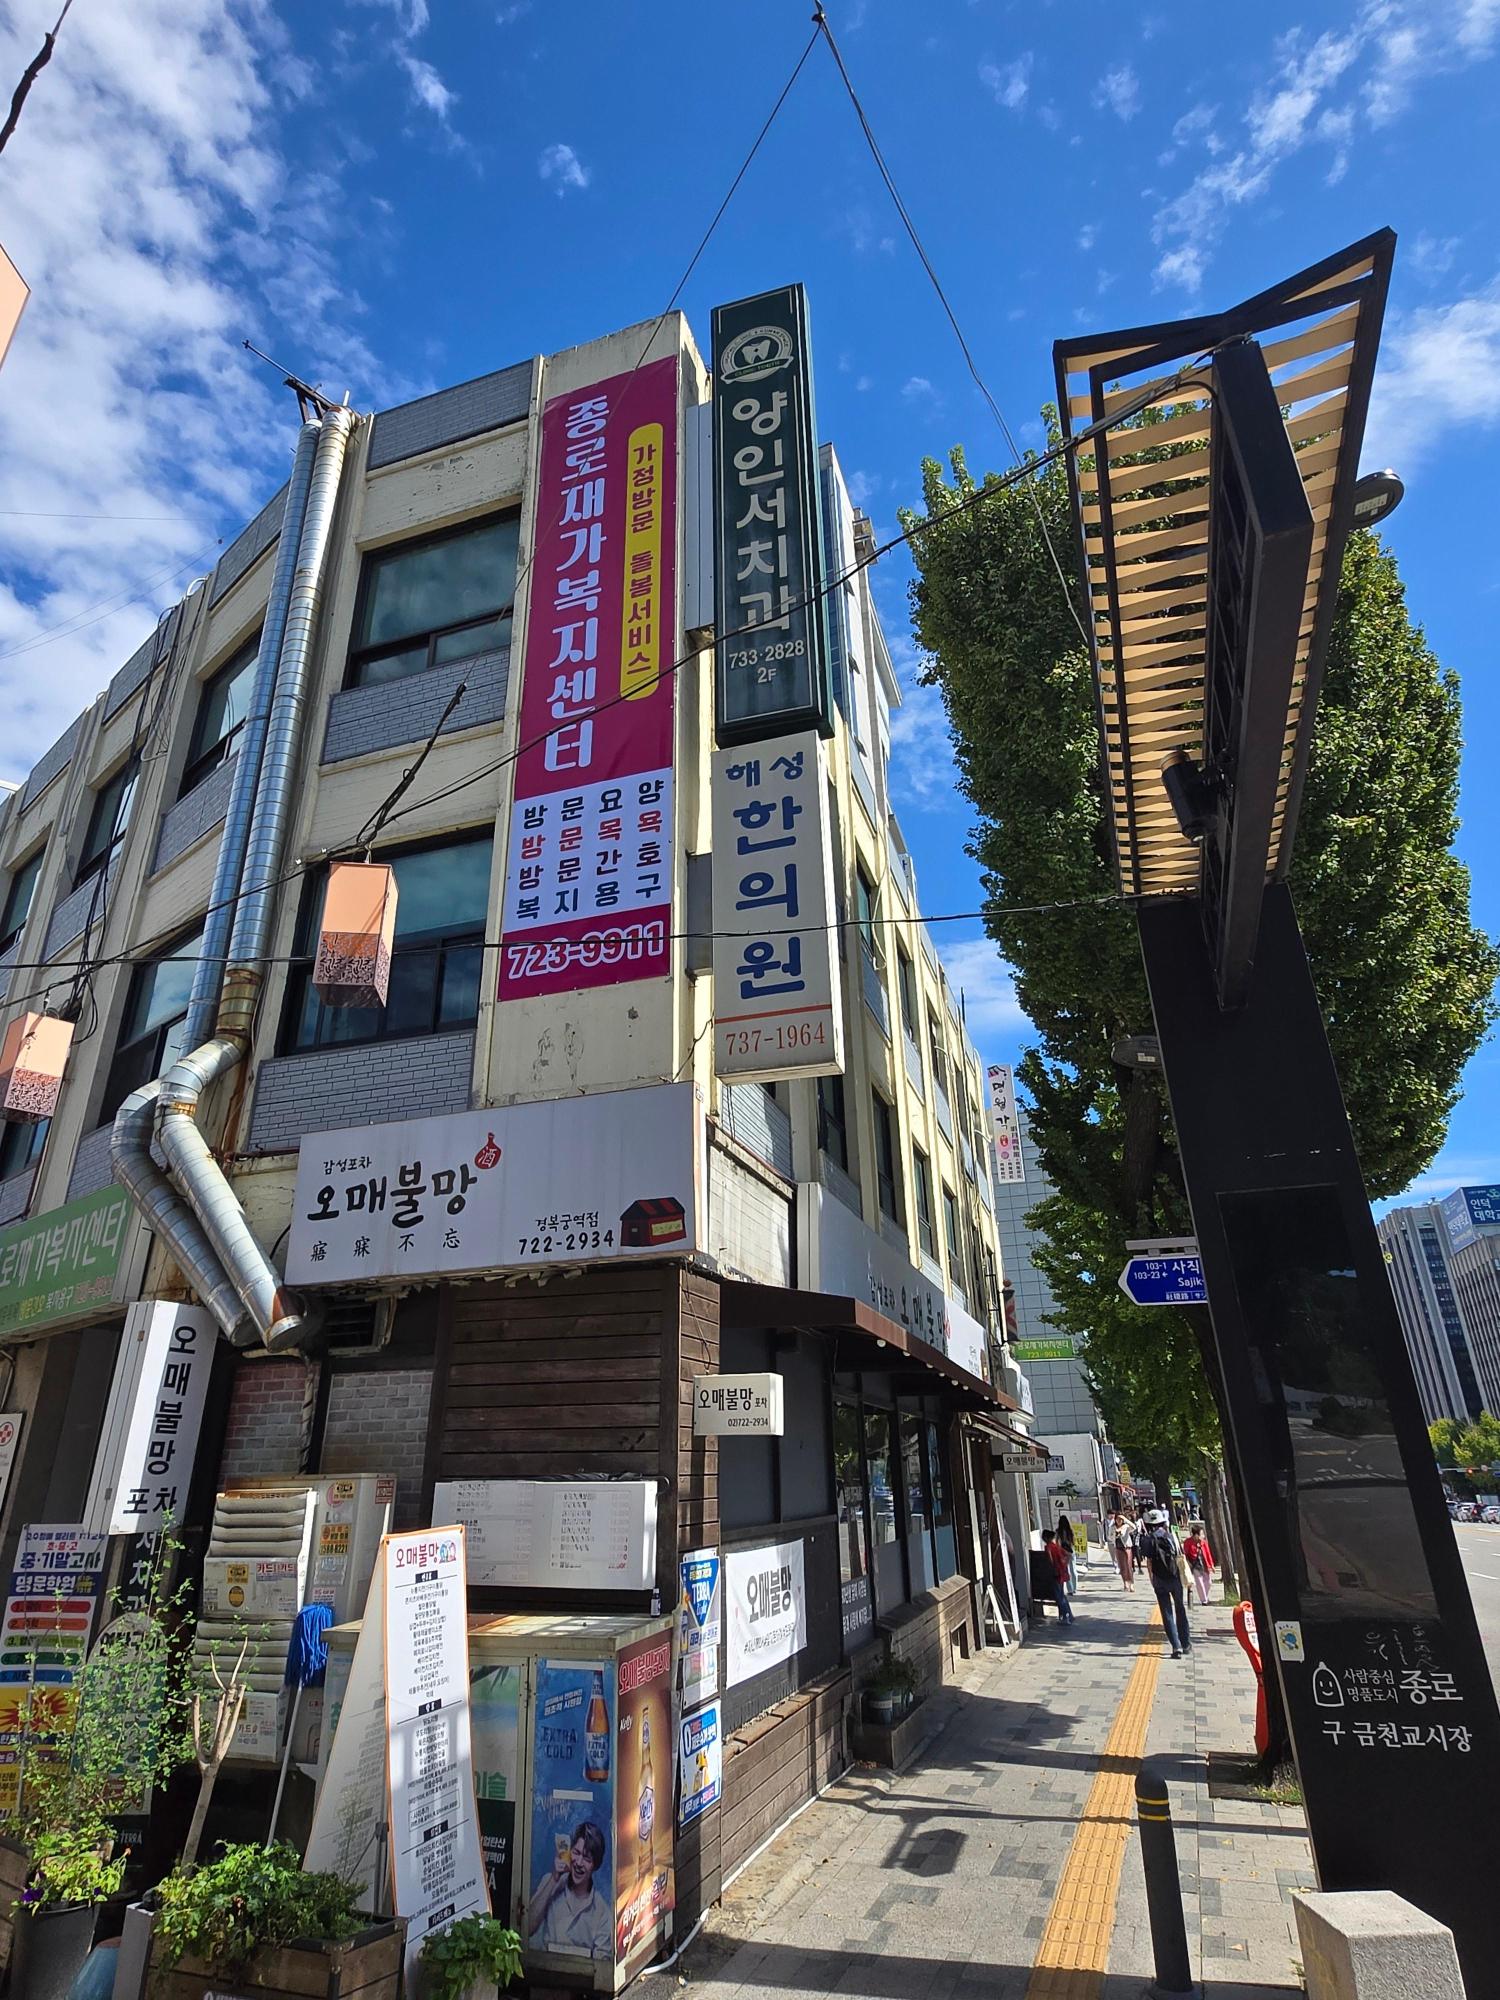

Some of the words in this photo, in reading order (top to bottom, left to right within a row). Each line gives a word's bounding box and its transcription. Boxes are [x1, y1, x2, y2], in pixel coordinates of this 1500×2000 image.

[631, 444, 656, 533] 가정방문
[732, 391, 797, 634] 양인서치과
[544, 395, 610, 773] 종로재가복지센터
[627, 550, 655, 676] 돌봄서비스
[757, 668, 777, 683] 2F
[726, 752, 804, 787] 해성
[523, 779, 665, 830] 방문요양
[520, 810, 663, 860] 방문목욕
[519, 842, 662, 890] 방문간호
[516, 873, 662, 920] 복지용구
[733, 796, 805, 1000] 한의원
[507, 920, 665, 980] 723-9911
[726, 1021, 826, 1057] 737-1964
[323, 1155, 373, 1176] 감성포차
[307, 1161, 478, 1228] 오매불망
[1470, 1198, 1491, 1210] 인덕
[535, 1211, 600, 1231] 경복궁역점
[518, 1229, 615, 1256] 722-2934
[1134, 1271, 1160, 1280] 103-23
[1145, 1261, 1167, 1271] 103-1
[147, 1325, 198, 1476] 오매불망
[698, 1387, 754, 1412] 오매불망
[755, 1397, 768, 1409] 포차
[123, 1486, 178, 1515] 포차
[20, 1552, 101, 1569] 중·기말고사
[395, 1543, 439, 1569] 오매불망
[16, 1575, 76, 1593] 명문학원
[746, 1564, 792, 1624] 오매불망
[1343, 1668, 1395, 1686] 사람중심
[1399, 1669, 1464, 1705] 종로
[1346, 1686, 1399, 1704] 명품도시
[542, 1725, 578, 1744] EXTRA
[1322, 1720, 1346, 1746] 구
[1352, 1722, 1473, 1753] 금천교시장
[545, 1743, 573, 1761] COLD
